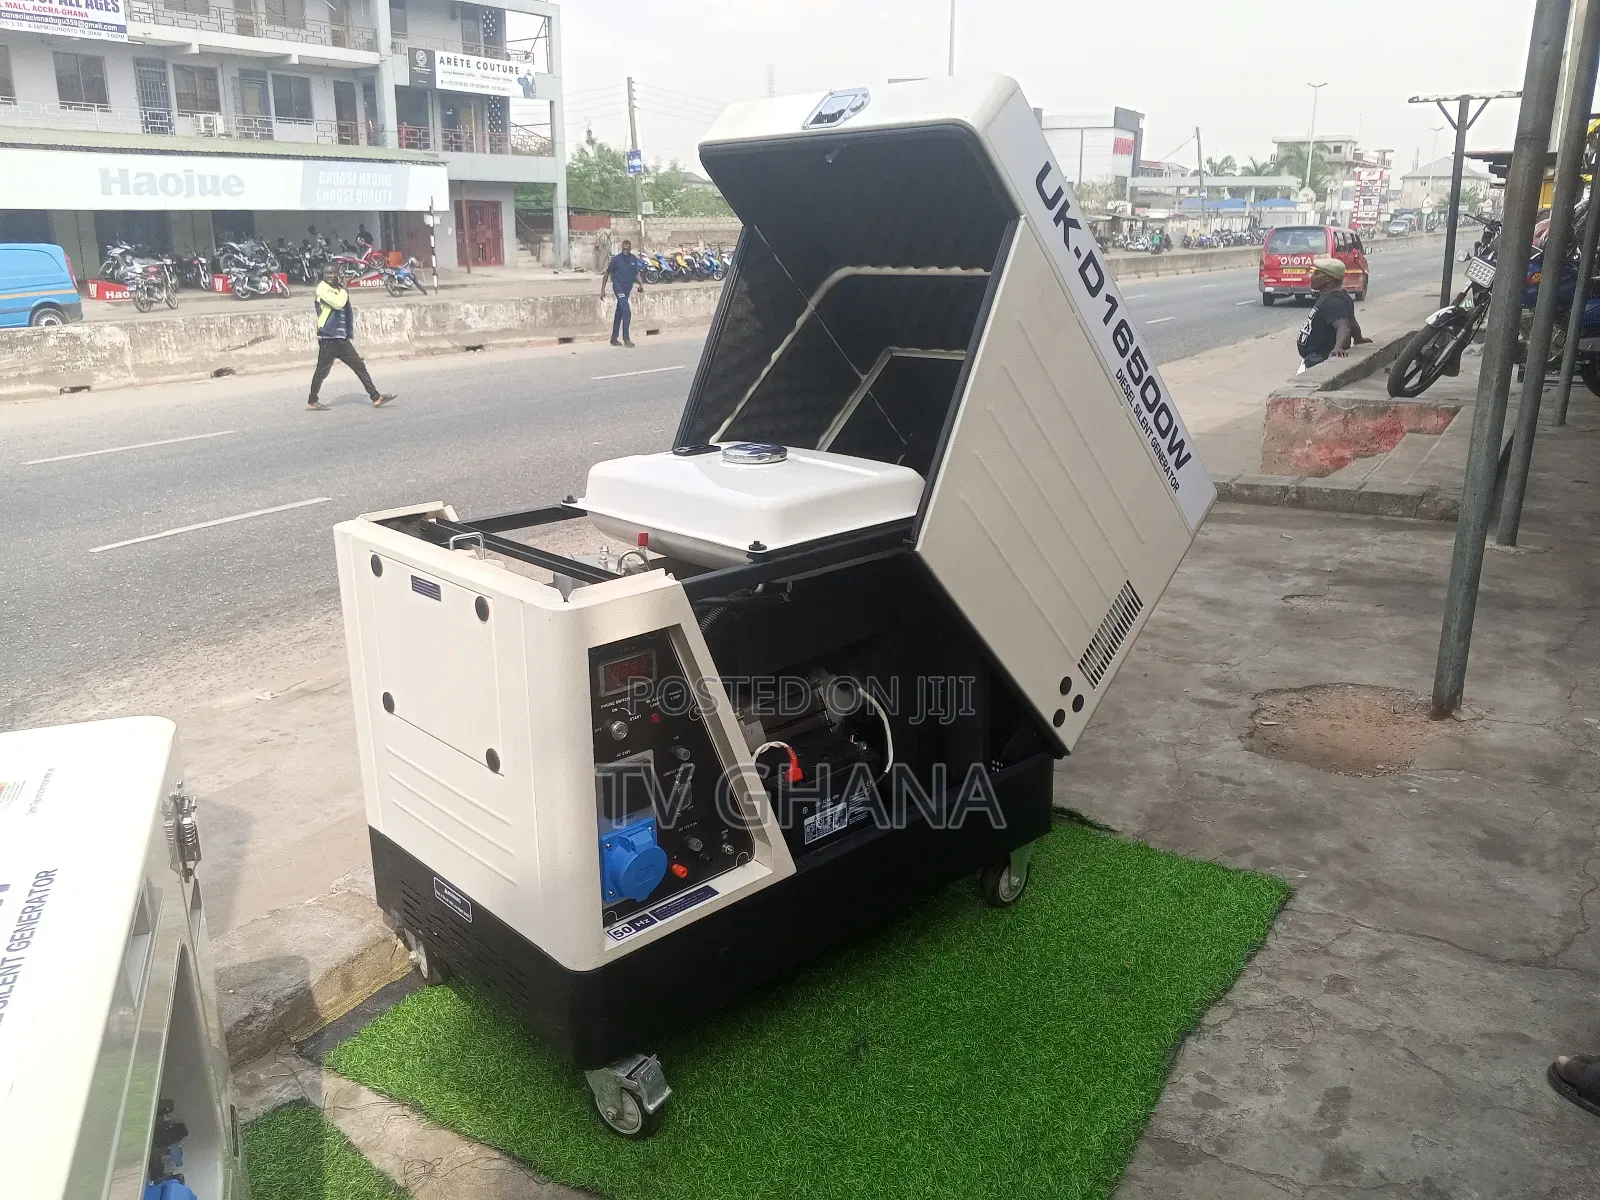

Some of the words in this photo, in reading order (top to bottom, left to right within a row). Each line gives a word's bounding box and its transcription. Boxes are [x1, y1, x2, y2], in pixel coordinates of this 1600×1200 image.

[32, 5, 89, 18] ACCRA-GHANA
[439, 55, 472, 69] ARÊTE
[476, 61, 520, 75] COUTURE
[98, 168, 245, 199] Haojue
[319, 170, 357, 185] CHOOSE
[316, 187, 354, 202] CHOOSE
[356, 188, 394, 203] QUALITY
[1278, 256, 1312, 265] OYOTA
[1035, 160, 1192, 471] UK-D16500W
[1115, 367, 1135, 406] DIESEL
[1133, 404, 1154, 440] SILENT
[1150, 436, 1180, 494] GENERATOR
[6, 868, 59, 953] GENERATOR
[612, 925, 633, 938] 50
[634, 918, 650, 927] Hz
